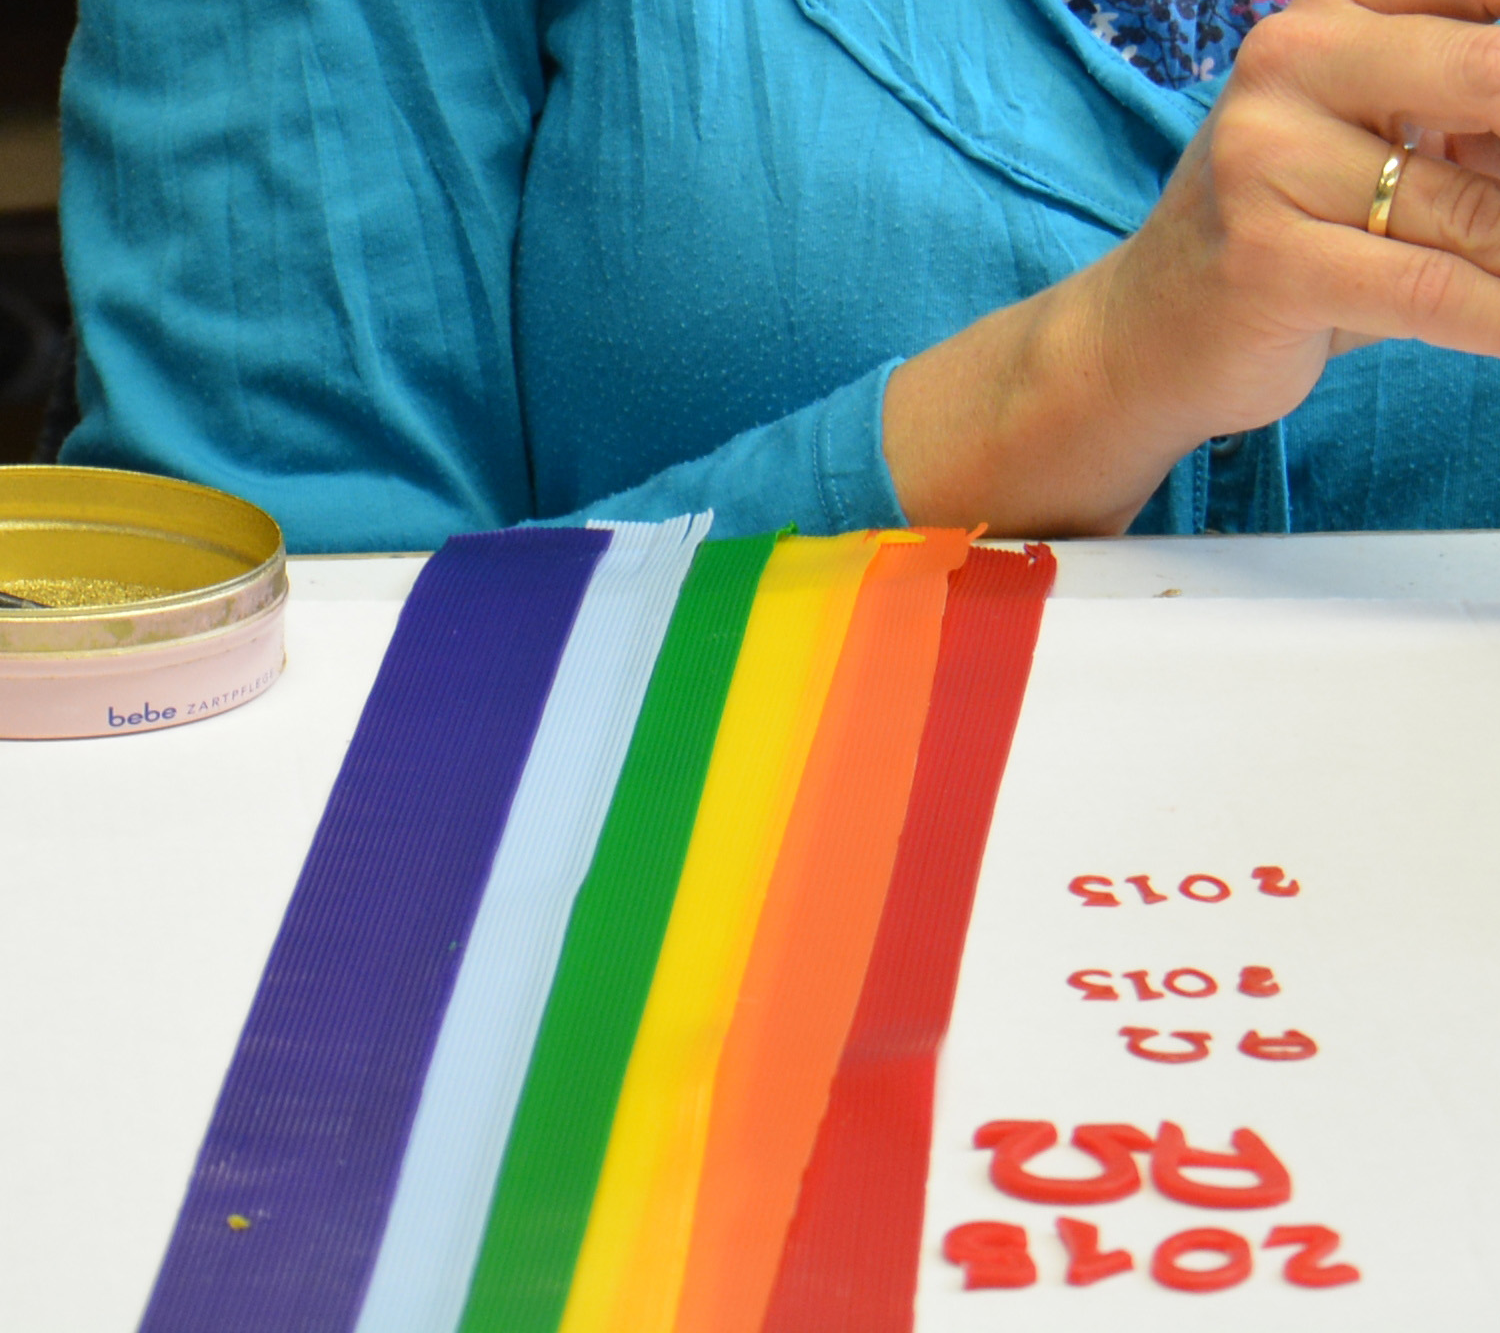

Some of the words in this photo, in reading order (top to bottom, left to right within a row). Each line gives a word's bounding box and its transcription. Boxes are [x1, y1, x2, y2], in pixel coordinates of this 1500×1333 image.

[108, 702, 177, 727] bebe
[187, 668, 274, 715] ZARTPFLEGE
[1067, 866, 1300, 907] 2015
[1066, 965, 1281, 1001] 2015
